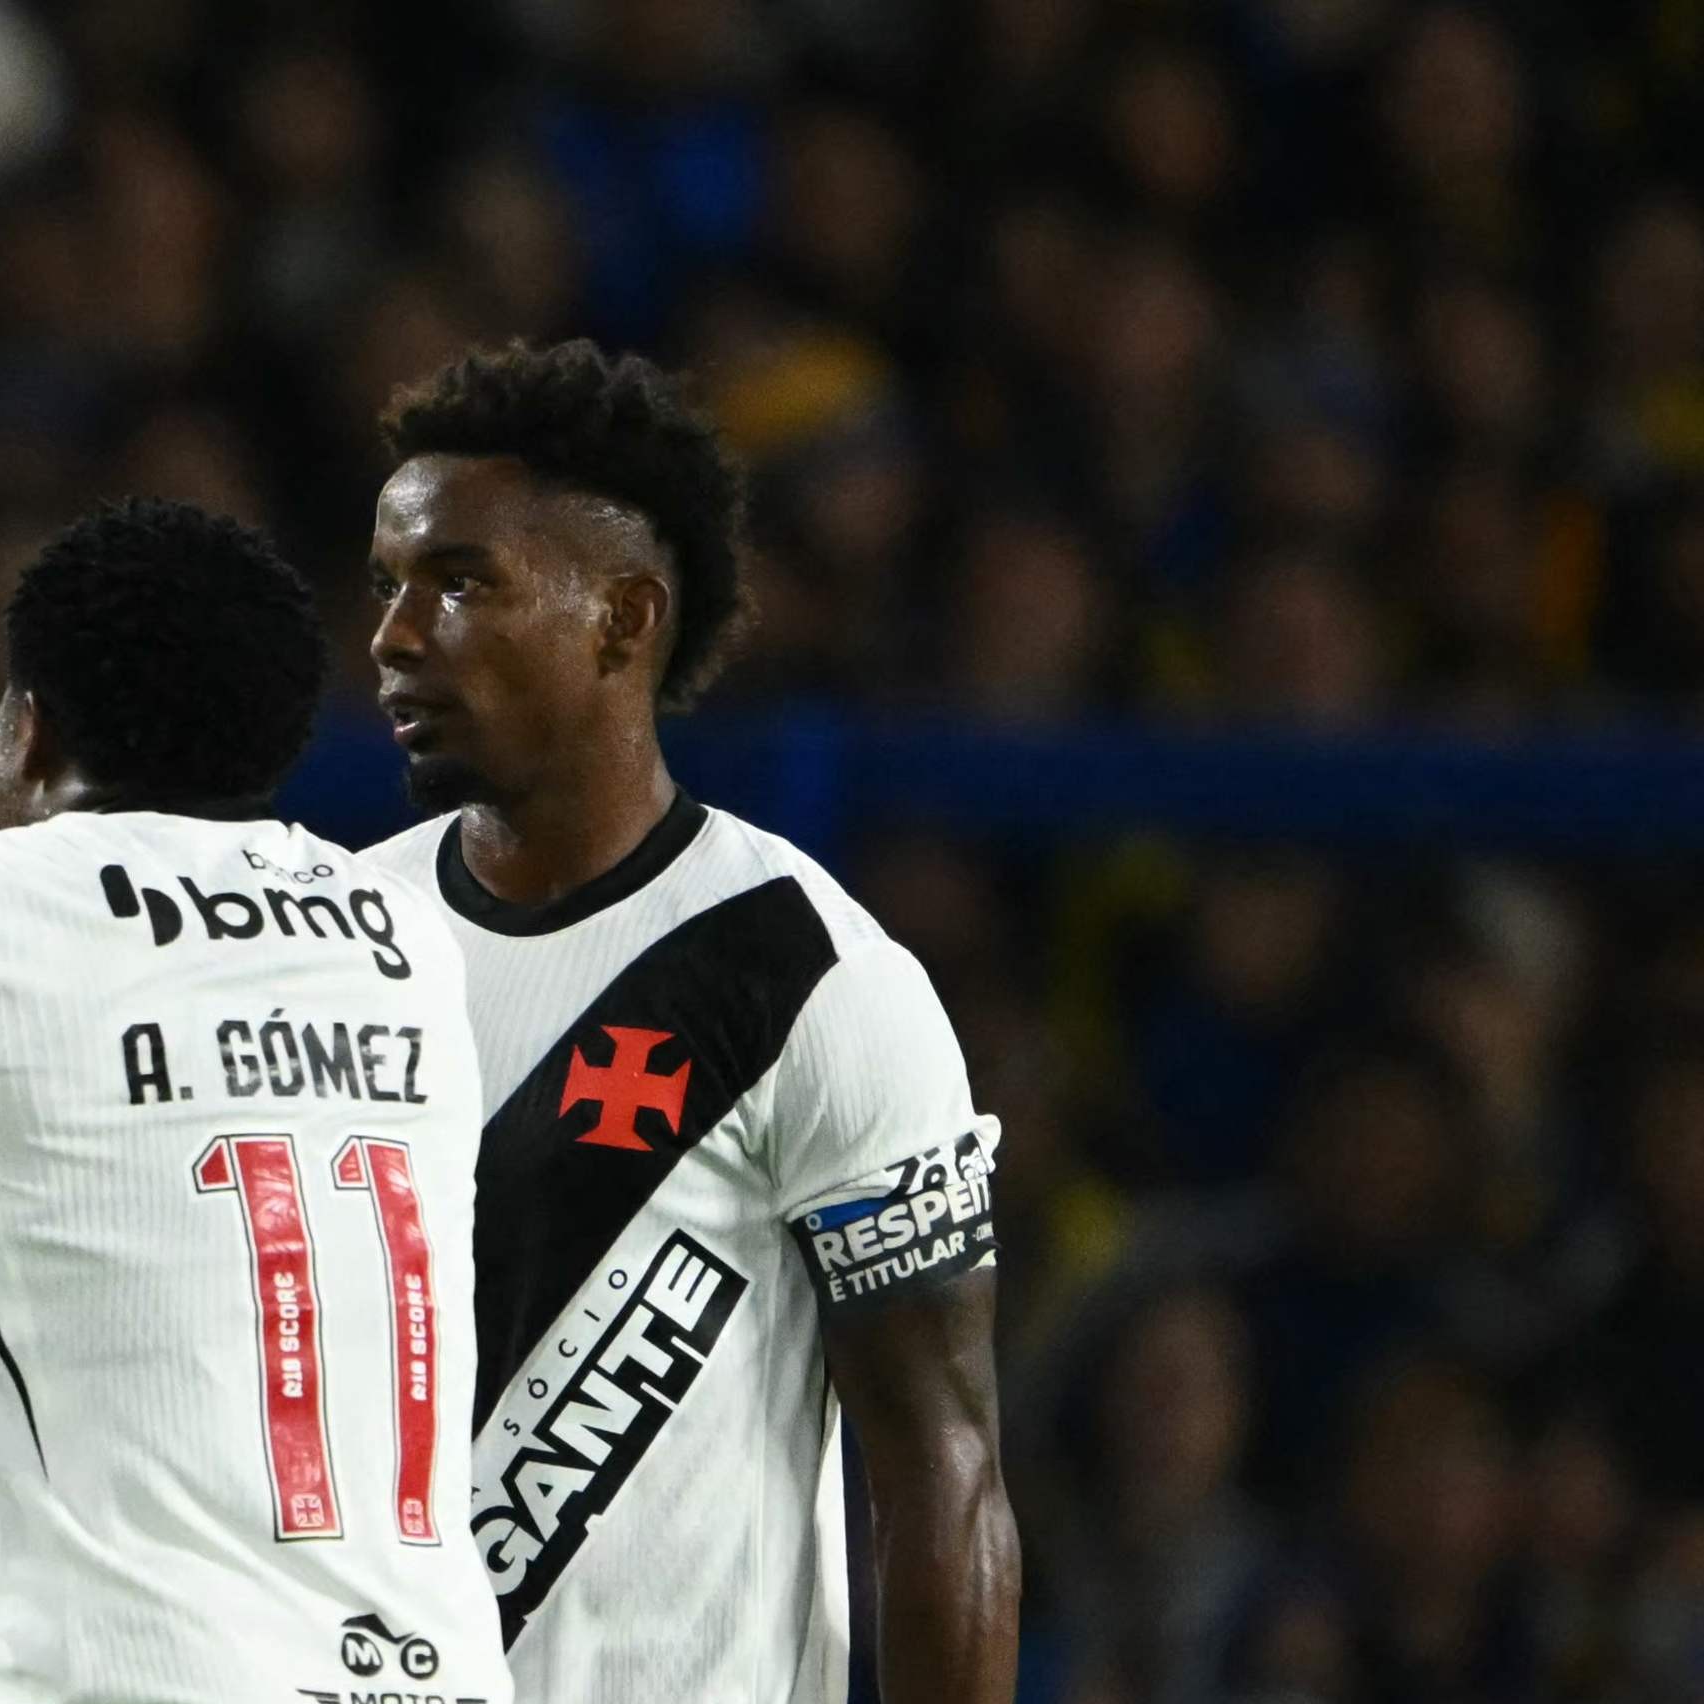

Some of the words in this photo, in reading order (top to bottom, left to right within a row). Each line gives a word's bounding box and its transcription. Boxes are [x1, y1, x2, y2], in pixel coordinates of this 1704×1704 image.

[177, 876, 412, 980] bmg
[122, 1022, 194, 1105] A.
[216, 1008, 428, 1105] GÓMEZ
[274, 1271, 300, 1352] SCORE
[846, 1231, 967, 1295] TITULAR
[192, 1133, 442, 1547] 11
[405, 1273, 427, 1355] SCORE
[502, 1268, 629, 1437] SÓCIO
